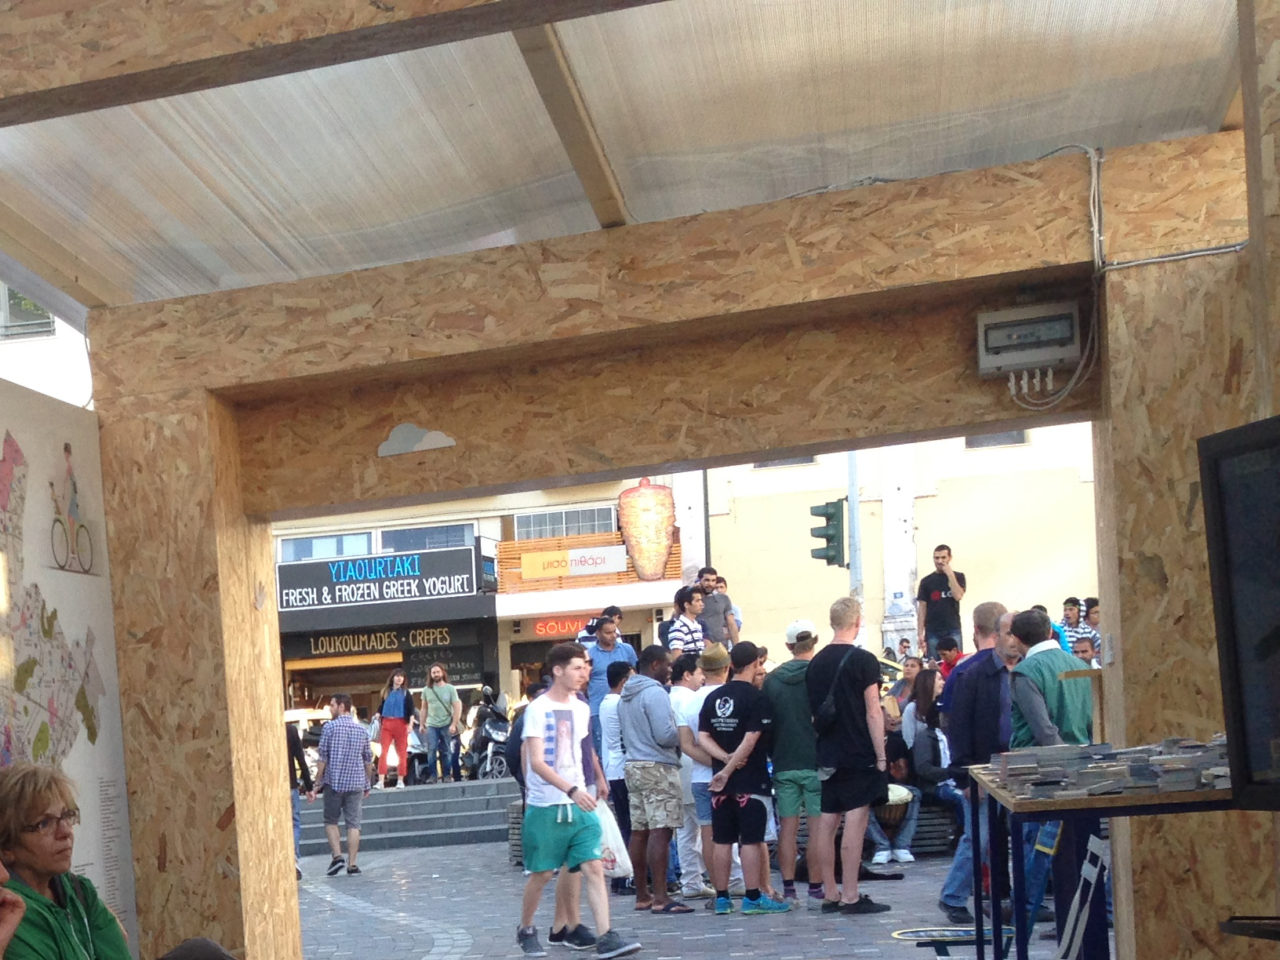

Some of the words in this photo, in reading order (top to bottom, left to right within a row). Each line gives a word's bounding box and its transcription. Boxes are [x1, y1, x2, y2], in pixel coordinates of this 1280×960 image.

[328, 555, 421, 583] YIAOURTAKI
[282, 586, 318, 608] FRESH
[322, 586, 332, 604] &
[335, 582, 379, 603] FROZEN
[383, 578, 420, 599] GREEK
[422, 574, 470, 595] YOGURT
[310, 631, 398, 655] LOUKOUMADES
[409, 628, 450, 647] CREPES
